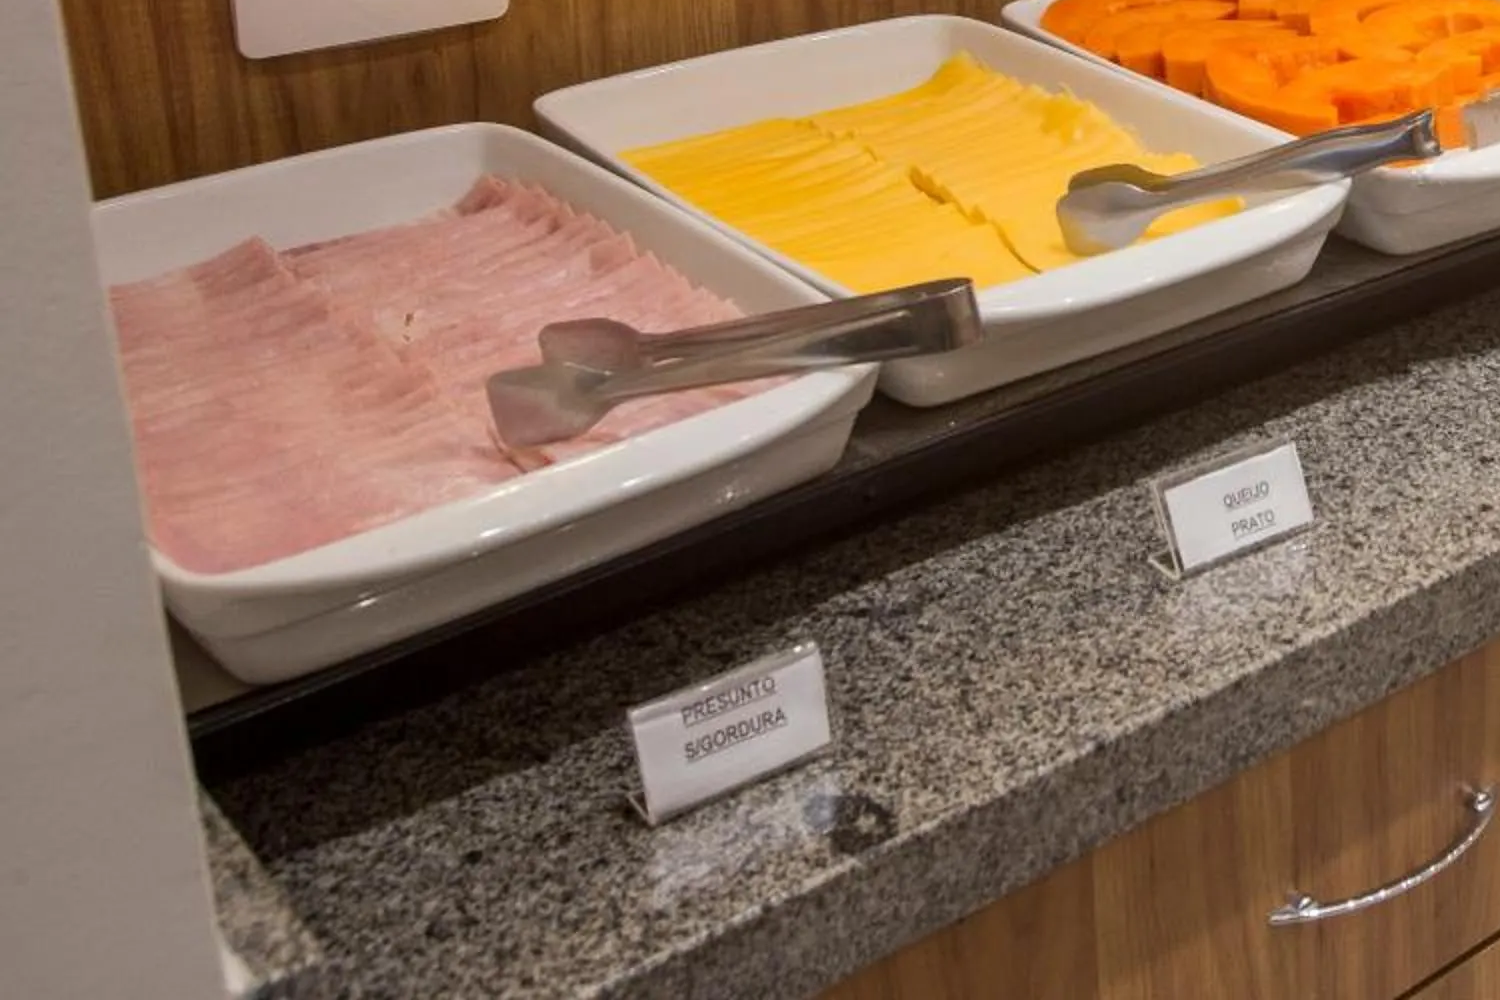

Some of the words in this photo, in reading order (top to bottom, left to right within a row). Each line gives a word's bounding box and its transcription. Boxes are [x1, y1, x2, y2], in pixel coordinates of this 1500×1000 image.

[1222, 480, 1271, 509] QUEIJO
[1231, 509, 1276, 536] PRATO
[681, 676, 776, 725] PRESUNTO
[684, 707, 787, 760] S/GORDURA
